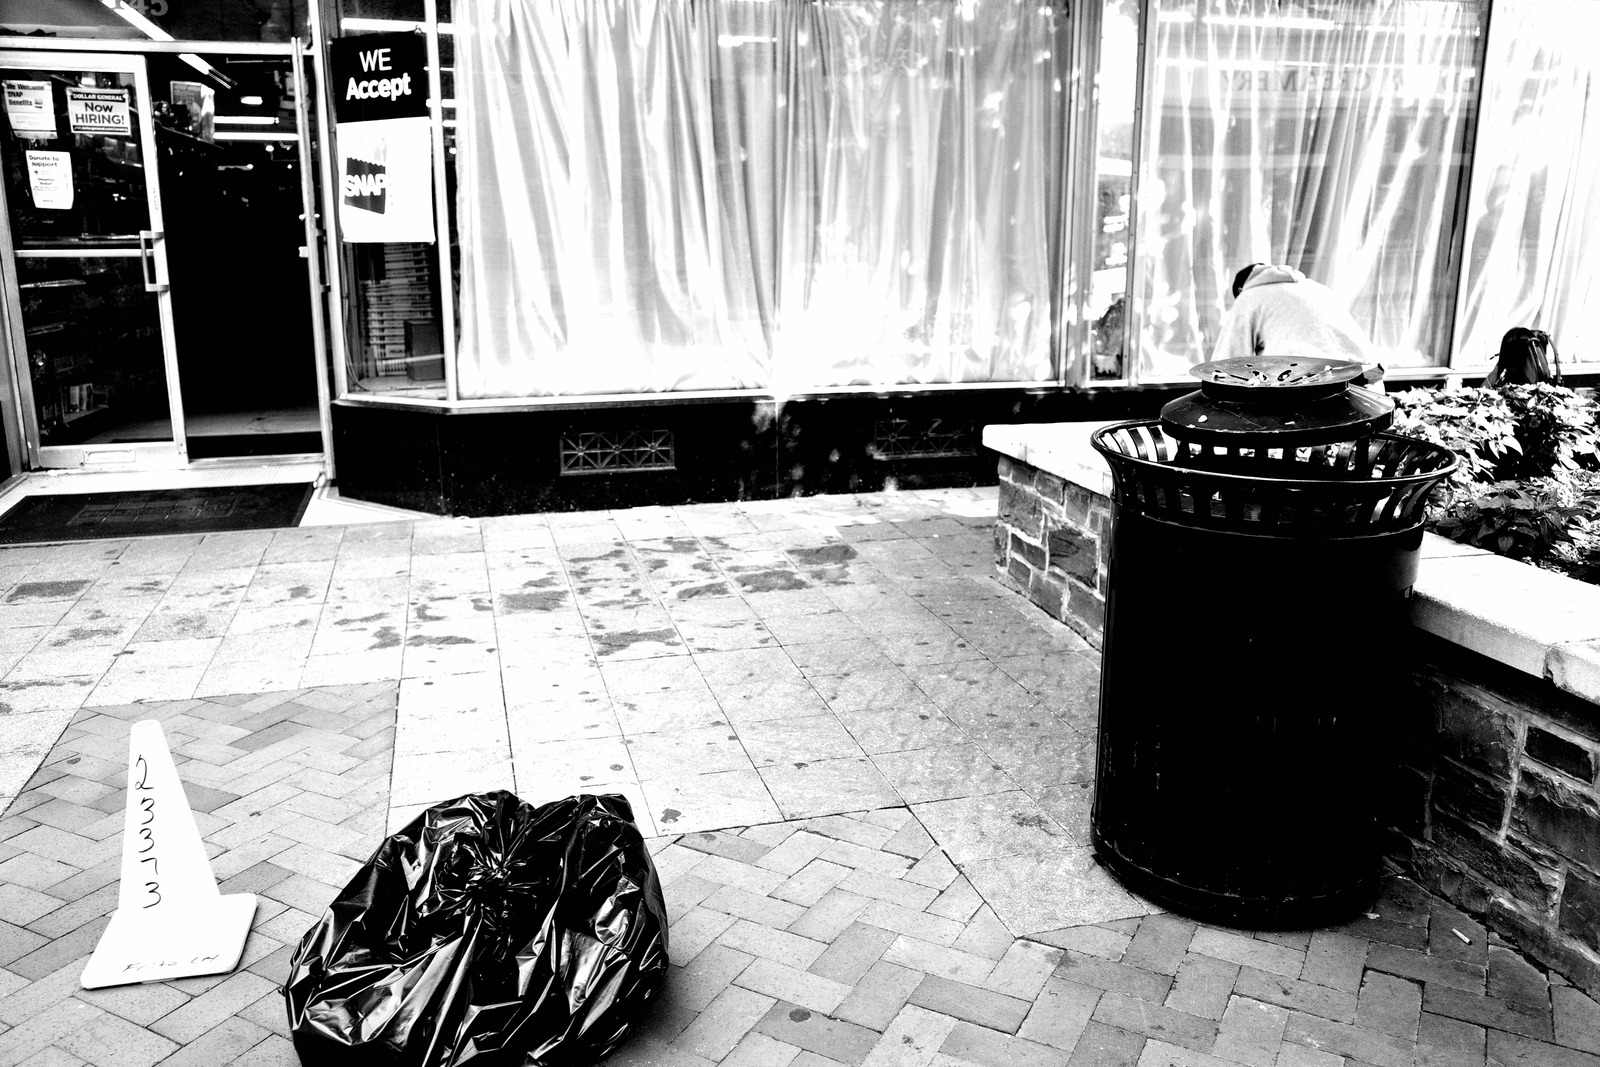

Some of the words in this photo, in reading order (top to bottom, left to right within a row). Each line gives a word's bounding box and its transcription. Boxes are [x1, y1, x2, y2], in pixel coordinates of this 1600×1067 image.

[359, 47, 393, 73] WE
[345, 72, 412, 102] Accept
[75, 113, 125, 125] HIRING!
[344, 173, 386, 198] SNAP
